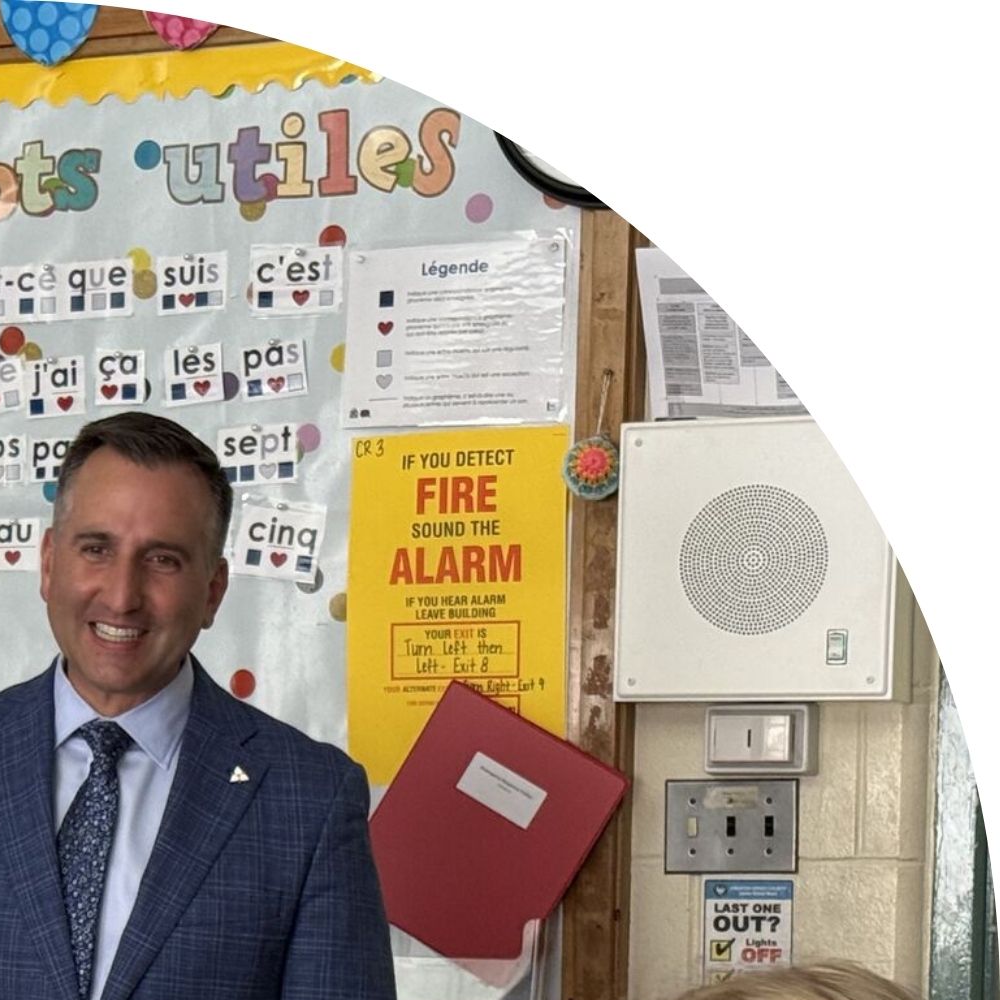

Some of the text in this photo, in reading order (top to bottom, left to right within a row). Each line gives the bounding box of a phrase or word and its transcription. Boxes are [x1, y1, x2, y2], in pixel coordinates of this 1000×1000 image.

[162, 107, 461, 205] utiles
[164, 258, 219, 287] suis
[257, 254, 332, 283] c'est
[421, 259, 489, 279] Légende
[68, 265, 127, 297] que
[99, 354, 138, 381] ça
[173, 349, 216, 376] les
[243, 343, 300, 377] pas
[32, 361, 78, 396] j'ai
[33, 440, 70, 468] pa
[223, 426, 292, 460] sept
[355, 439, 384, 458] CR 3
[402, 449, 514, 470] IF YOU DETECT
[416, 475, 498, 515] FIRE
[249, 517, 318, 554] cinq
[412, 520, 500, 539] SOUND THE
[389, 544, 522, 585] ALARM
[406, 594, 506, 607] IF YOU HEAR ALARM
[415, 607, 496, 620] LEAVE BUILDING
[424, 628, 487, 639] YOUR EXIT IS
[404, 639, 503, 656] Turn Left then
[453, 657, 477, 673] Exit
[480, 657, 489, 672] 8
[714, 903, 781, 914] LAST ONE
[713, 915, 781, 932] OUT?
[741, 947, 782, 963] OFF
[745, 938, 777, 948] Lights
